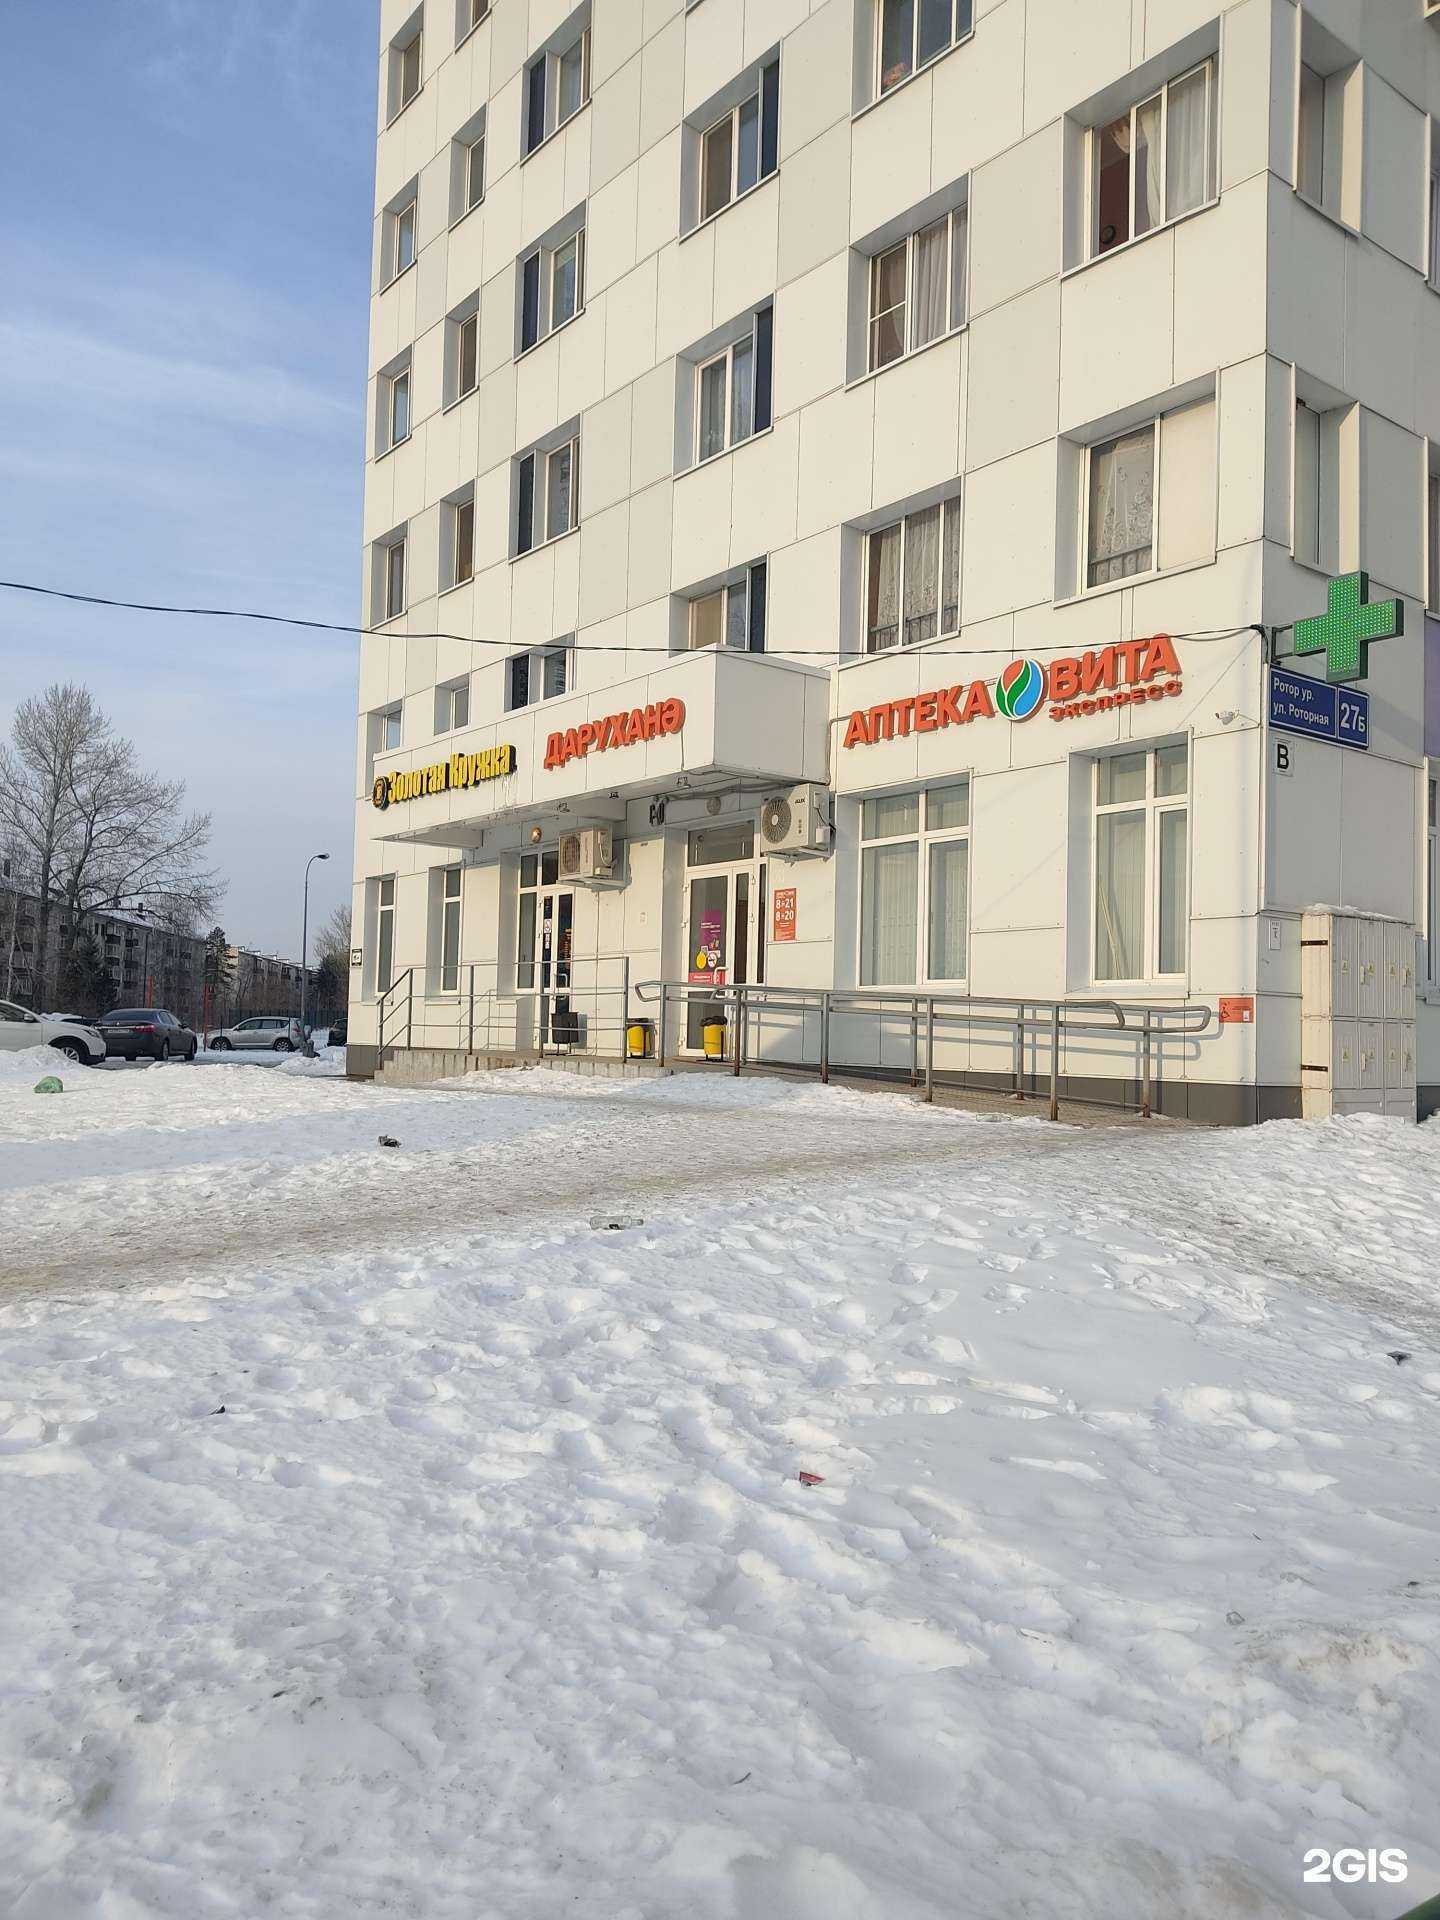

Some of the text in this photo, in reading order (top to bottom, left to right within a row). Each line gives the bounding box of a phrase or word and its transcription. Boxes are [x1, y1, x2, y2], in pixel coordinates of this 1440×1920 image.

[1050, 633, 1183, 701] ВИТА
[1273, 677, 1315, 703] Ротор ур.
[843, 680, 996, 748] АПТЕКА
[1048, 679, 1184, 721] ЭКСПРЕСС
[1272, 701, 1329, 726] ул. Роторная
[1340, 702, 1366, 733] 27Б
[544, 698, 686, 771] ДАРУХАНӘ
[388, 744, 512, 804] Золотая Кружка
